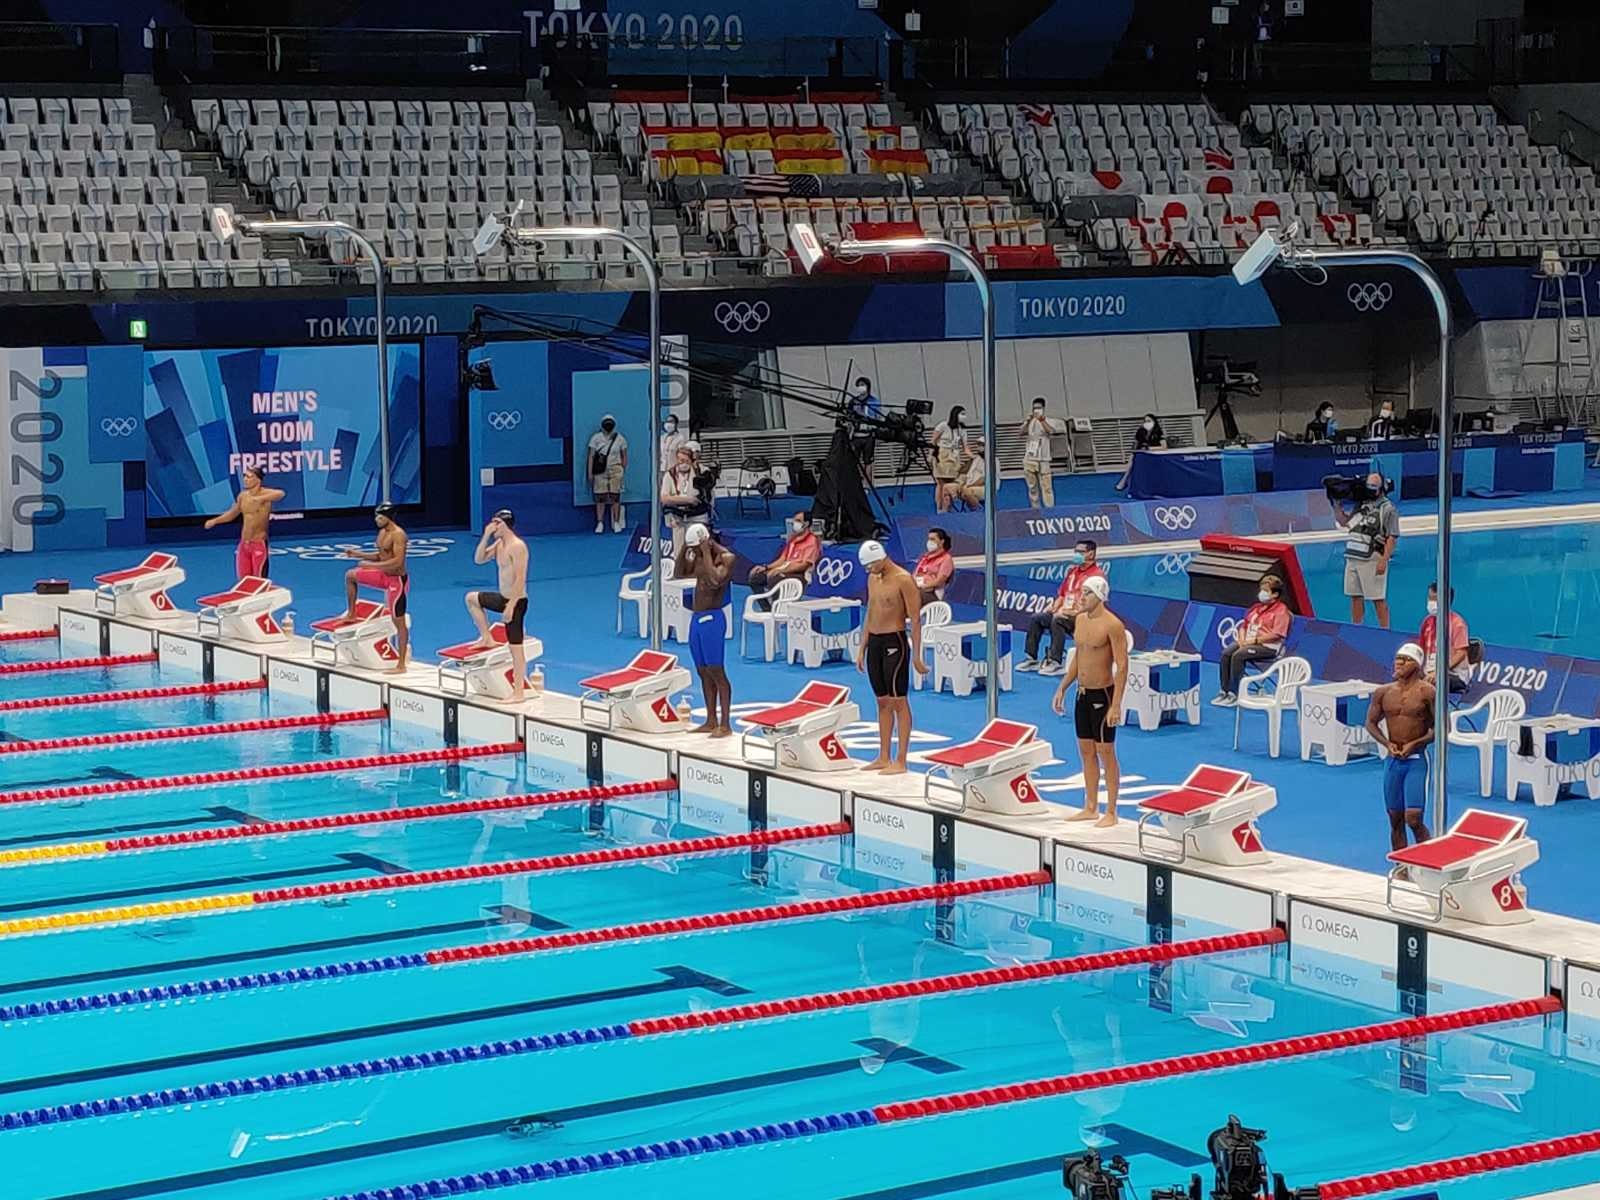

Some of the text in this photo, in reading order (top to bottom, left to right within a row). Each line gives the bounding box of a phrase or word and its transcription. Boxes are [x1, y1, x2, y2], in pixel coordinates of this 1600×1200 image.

[523, 11, 743, 50] TOKYO 2020
[1020, 295, 1126, 318] TOKYO 2020
[305, 315, 438, 338] TOKYO 2020
[252, 390, 318, 414] MEN'S
[257, 420, 315, 444] 100M
[9, 369, 66, 526] 2020
[229, 448, 342, 475] FREESTYLE
[1026, 515, 1111, 536] TOKYO 2020
[637, 536, 673, 556] TOYO
[156, 594, 165, 610] 0
[1025, 594, 1054, 613] 202
[263, 618, 271, 634] 1
[381, 643, 392, 659] 2
[1500, 664, 1548, 691] 2020
[402, 699, 425, 713] OMEGA
[658, 703, 669, 720] 4
[540, 732, 566, 748] OMEGA
[826, 739, 838, 758] 5
[695, 770, 725, 786] OMEGA
[1016, 780, 1029, 801] 6
[872, 811, 905, 830] OMEGA
[1237, 828, 1251, 849] 7
[1077, 861, 1115, 881] OMEGA
[1499, 885, 1513, 907] 8
[1315, 919, 1360, 941] OMEGA
